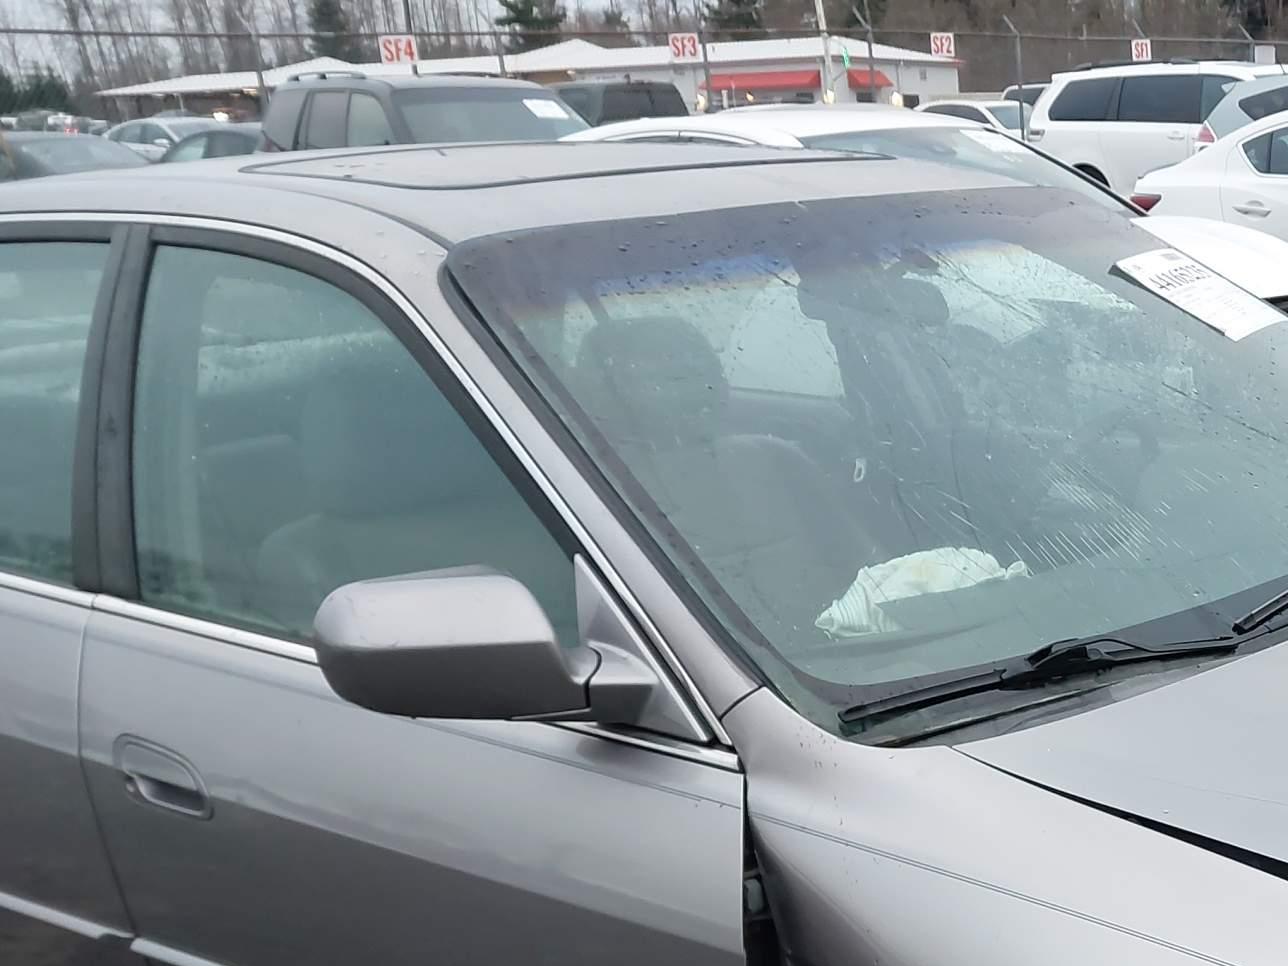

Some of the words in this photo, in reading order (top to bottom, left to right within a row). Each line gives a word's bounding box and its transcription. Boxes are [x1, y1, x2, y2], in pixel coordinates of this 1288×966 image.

[383, 38, 415, 62] SF4
[671, 35, 697, 57] SF3
[933, 35, 953, 54] SF2
[1134, 41, 1149, 59] SF1
